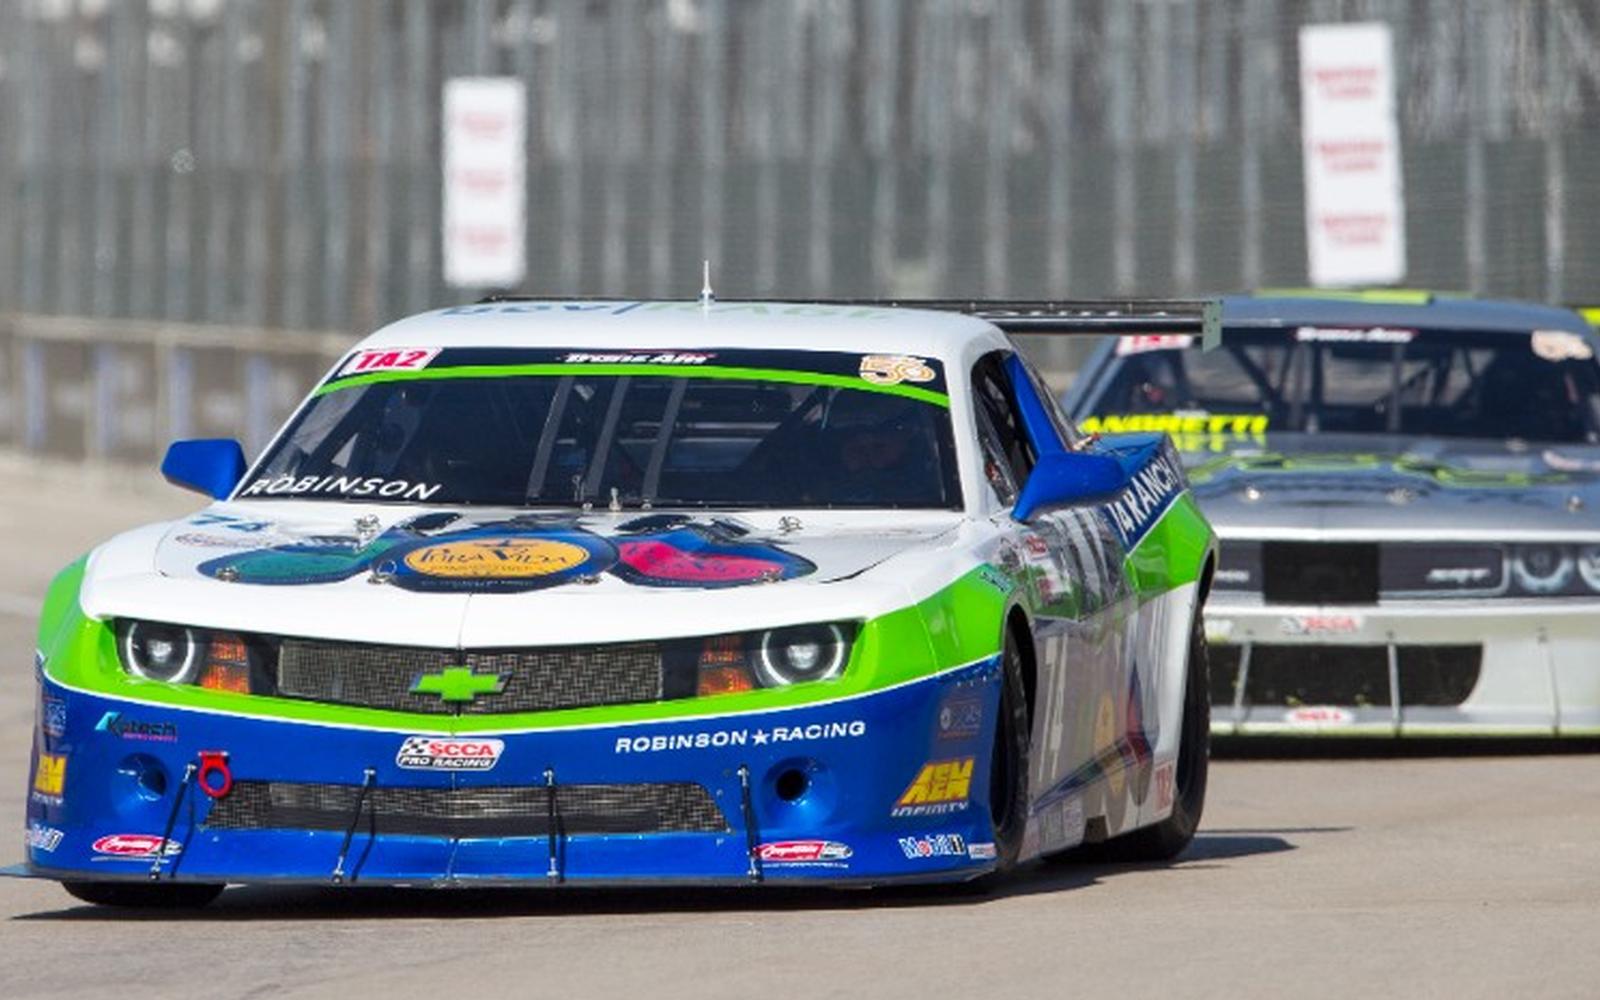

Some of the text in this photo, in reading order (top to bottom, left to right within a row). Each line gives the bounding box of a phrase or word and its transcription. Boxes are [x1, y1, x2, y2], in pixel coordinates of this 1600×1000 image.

[355, 350, 428, 371] TA2
[241, 475, 442, 500] ROBINSON
[429, 742, 495, 757] SCCA
[614, 721, 867, 754] ROBINSON RACING
[898, 758, 975, 804] AEM
